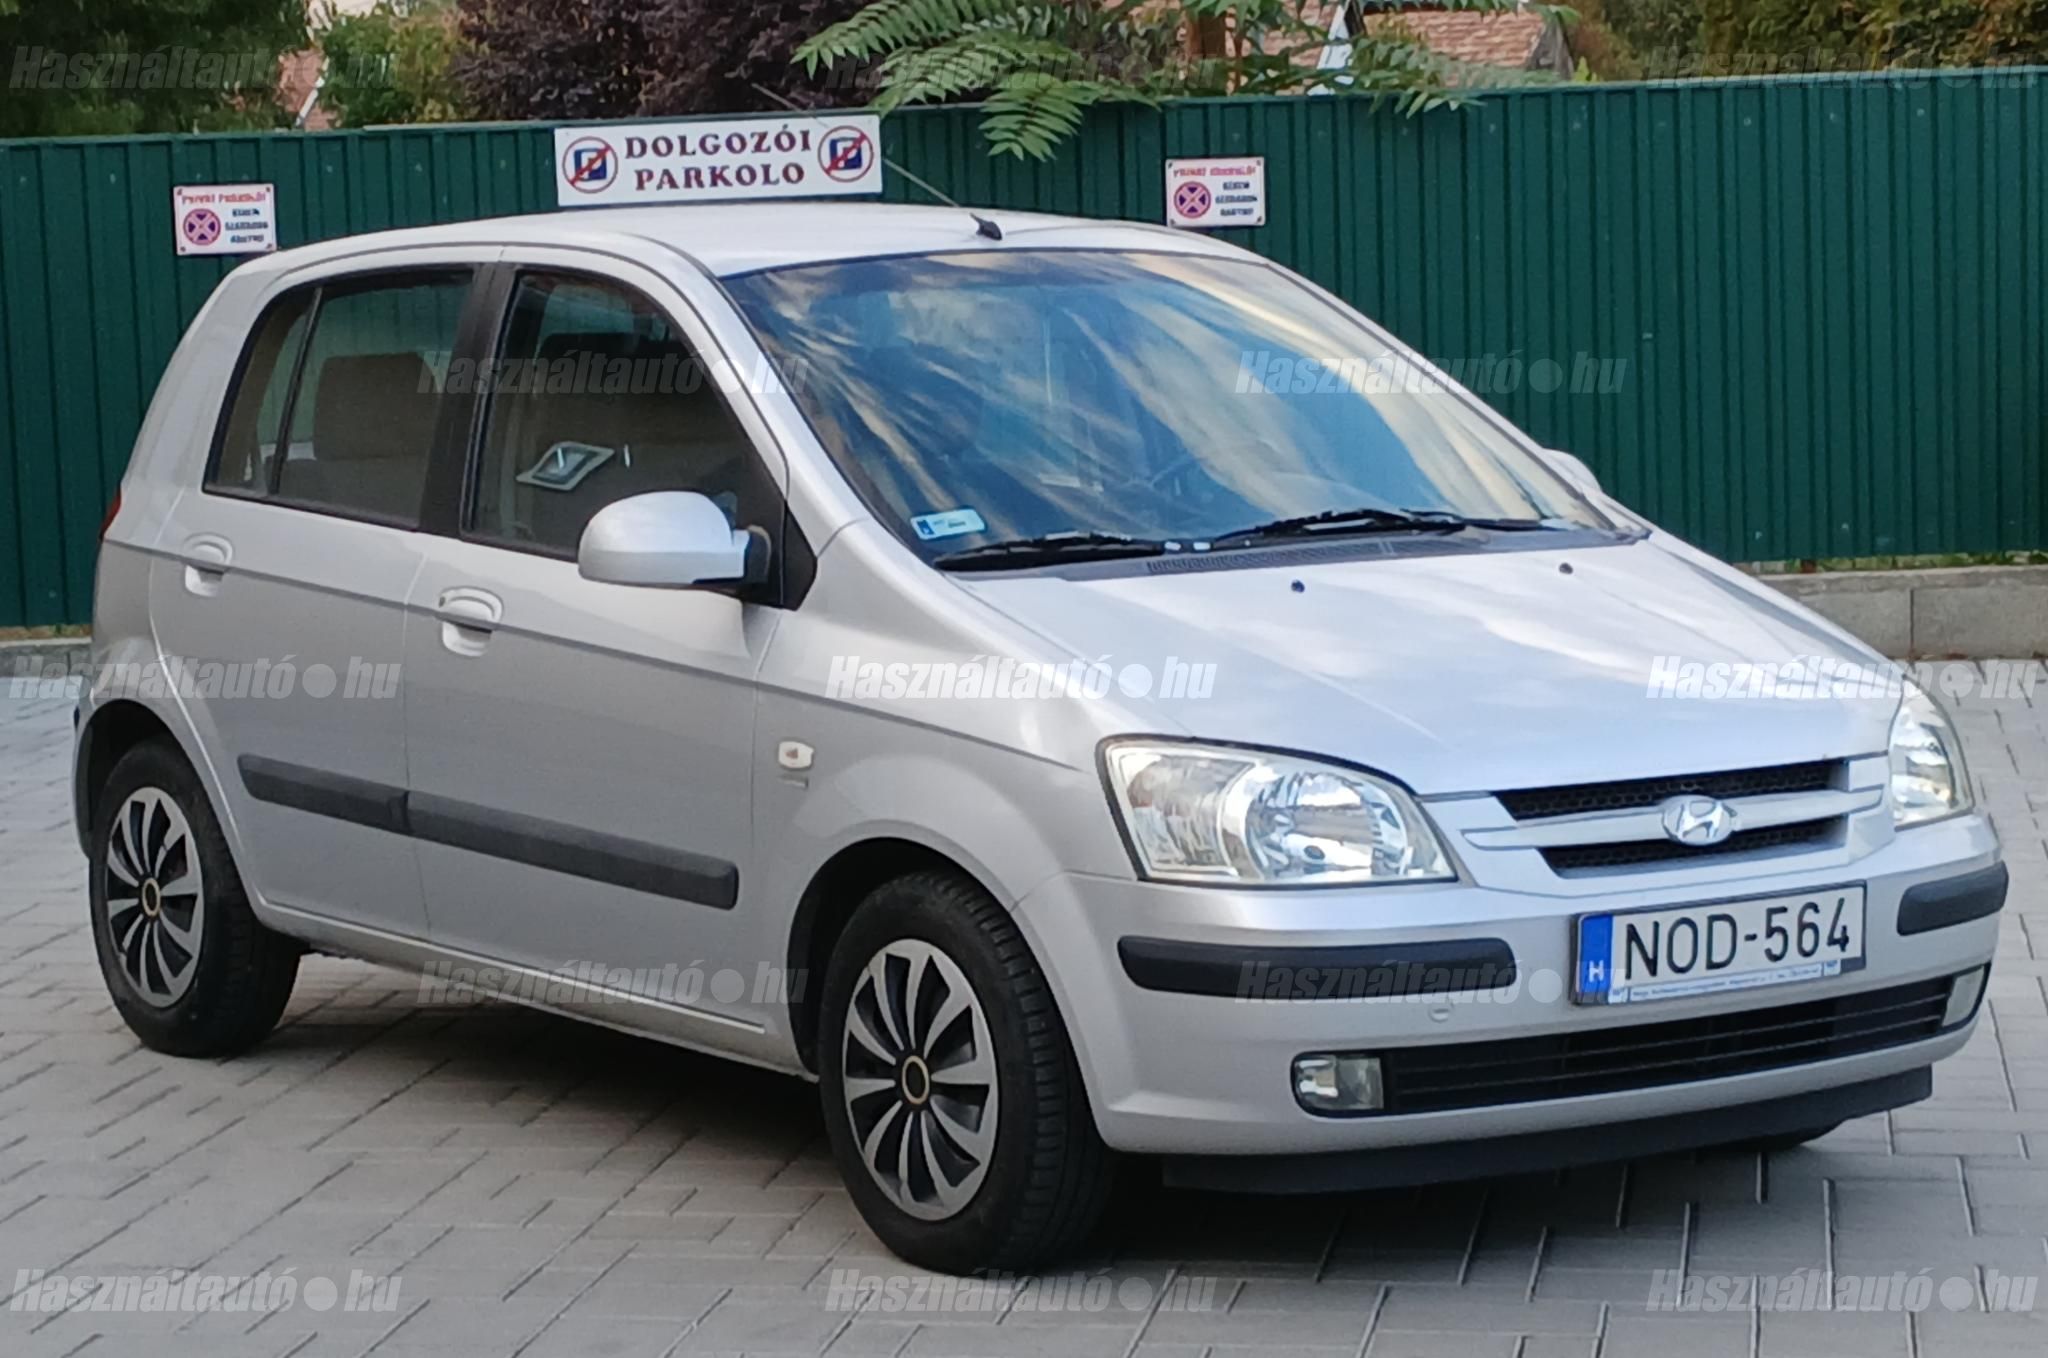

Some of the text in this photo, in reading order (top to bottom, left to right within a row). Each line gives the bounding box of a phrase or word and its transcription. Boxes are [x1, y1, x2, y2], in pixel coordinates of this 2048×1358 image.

[625, 124, 811, 159] DOLGOZÓI
[634, 162, 805, 191] PARKOLO
[1625, 897, 1850, 980] NOD-564
[1588, 960, 1604, 982] H
